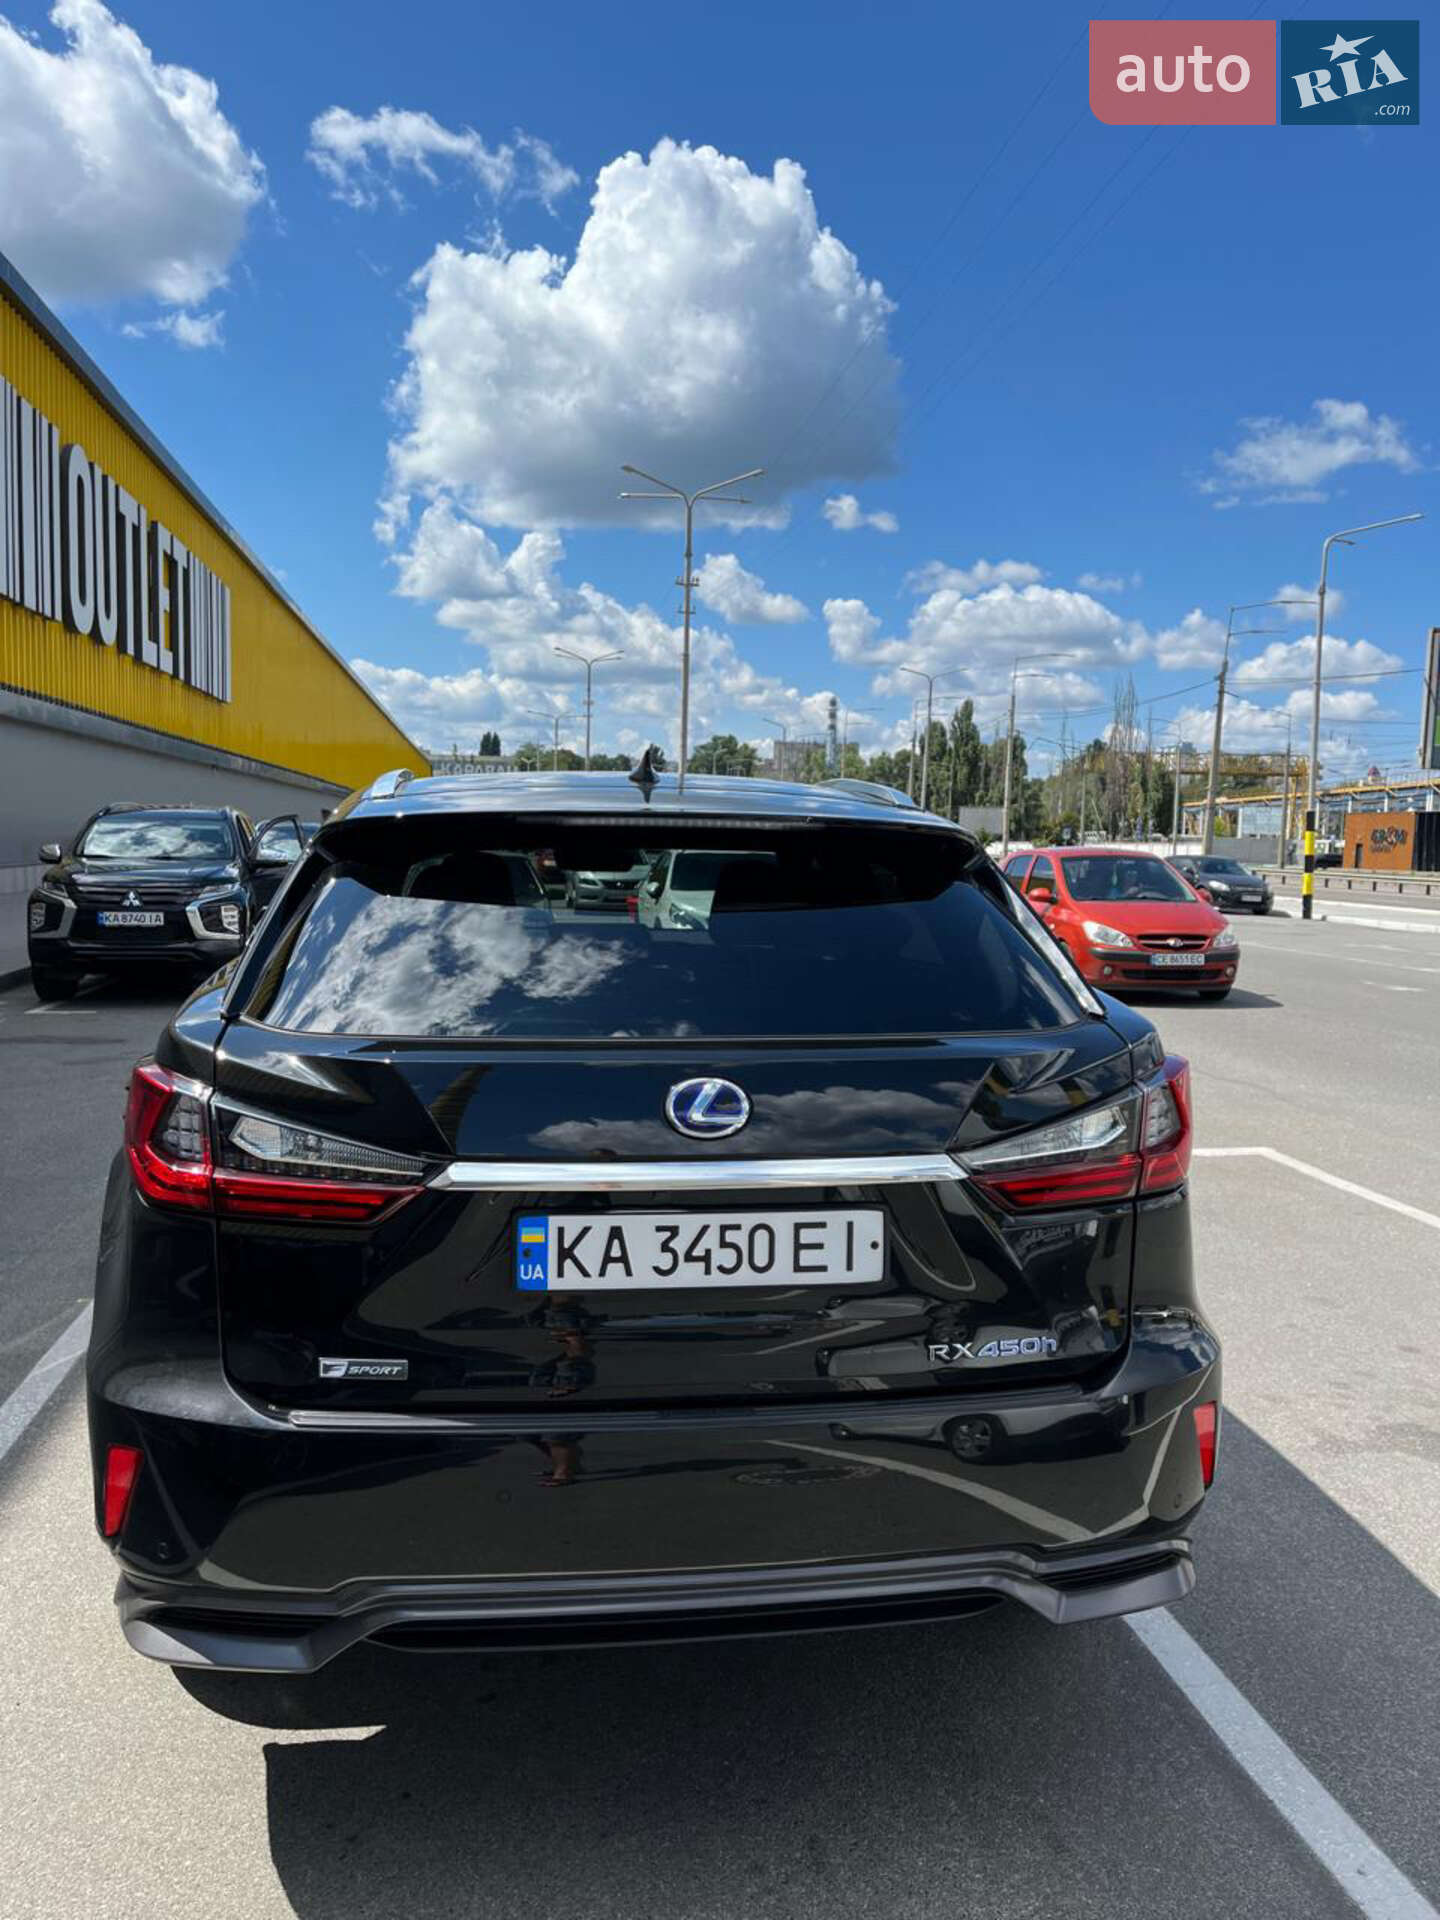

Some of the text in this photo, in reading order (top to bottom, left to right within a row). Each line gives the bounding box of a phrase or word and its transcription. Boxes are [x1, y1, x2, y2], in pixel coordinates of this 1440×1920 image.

[64, 443, 190, 681] OUTLET
[556, 1220, 854, 1278] KA 3450 EI
[520, 1263, 544, 1281] UA
[347, 1365, 402, 1376] SPORT
